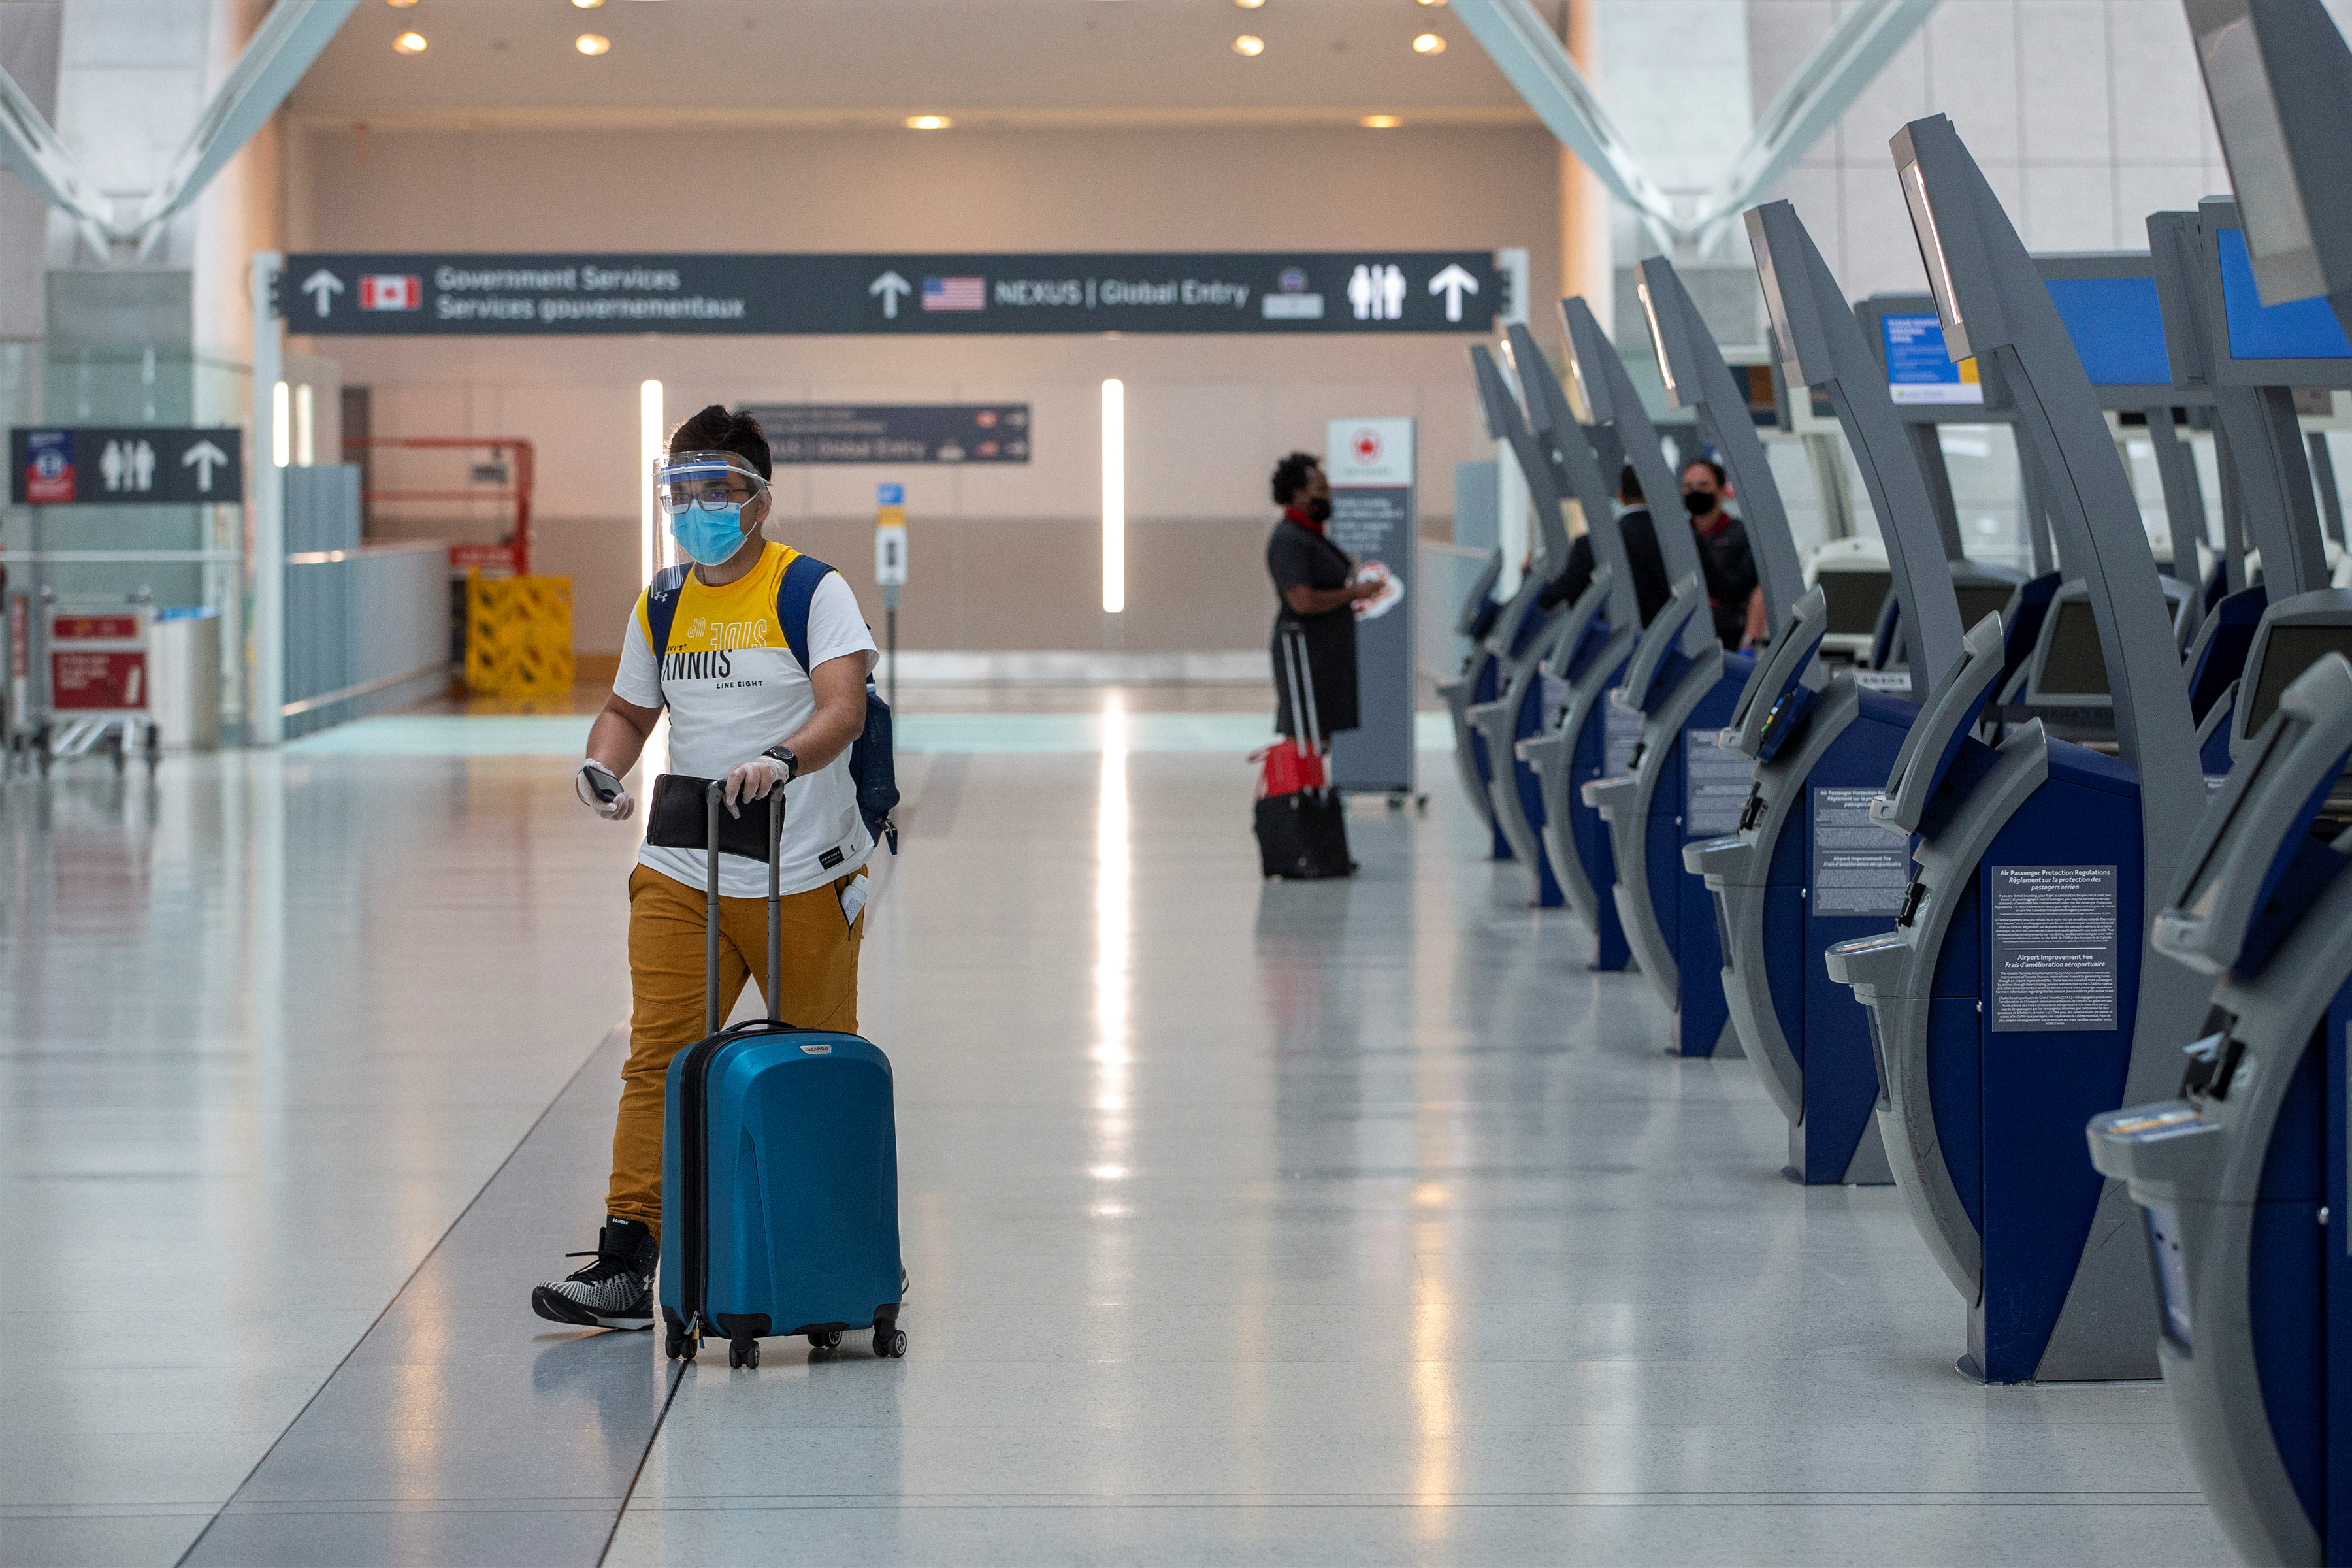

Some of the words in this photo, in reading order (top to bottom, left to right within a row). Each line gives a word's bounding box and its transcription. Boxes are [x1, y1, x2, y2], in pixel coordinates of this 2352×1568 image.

[435, 265, 578, 291] Government
[580, 265, 681, 291] Services
[994, 279, 1083, 305] NEXUS
[1100, 278, 1179, 306] Global
[1181, 278, 1250, 310] Entry
[435, 294, 535, 319] Services
[538, 294, 746, 323] gouvernementaux
[687, 617, 706, 638] UP
